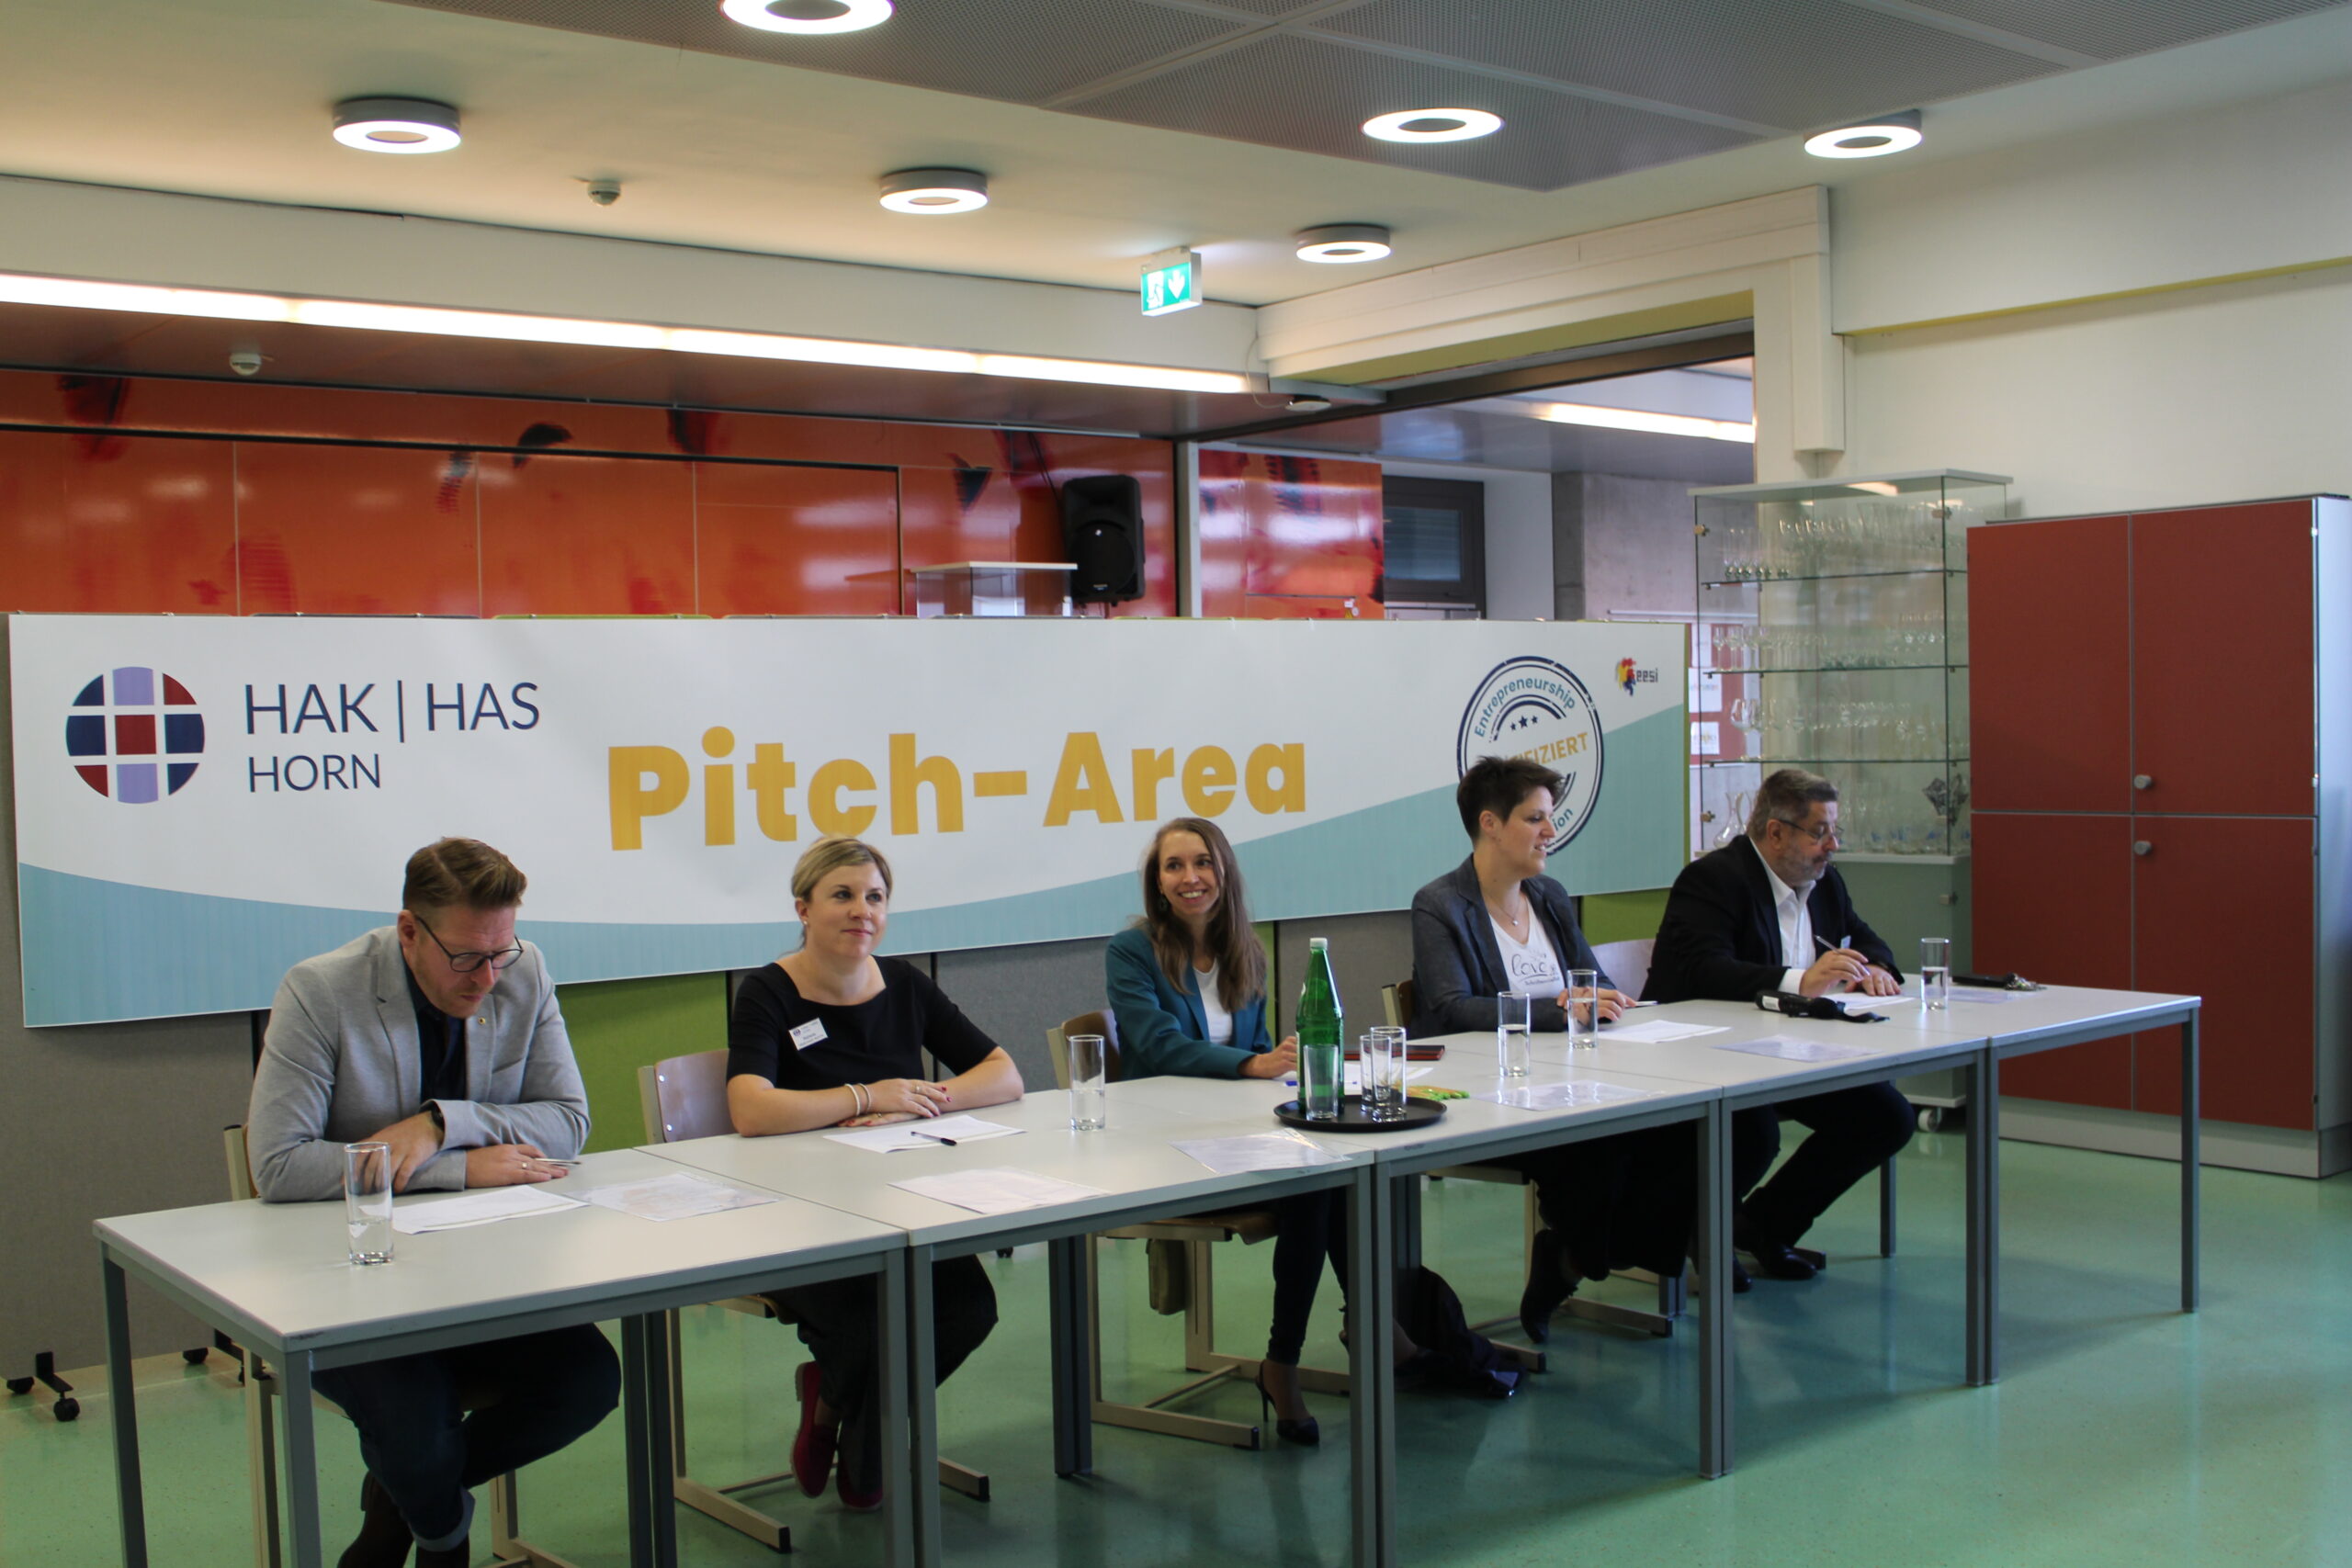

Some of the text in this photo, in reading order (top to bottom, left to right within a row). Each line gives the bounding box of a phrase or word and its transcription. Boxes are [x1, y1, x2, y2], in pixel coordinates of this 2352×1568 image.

[1636, 667, 1658, 682] eesi
[244, 682, 379, 734] HAK
[426, 682, 540, 732] HAS
[1474, 677, 1576, 738] Entrepreneurship
[249, 753, 381, 793] HORN
[607, 726, 1306, 852] Pitch-Area
